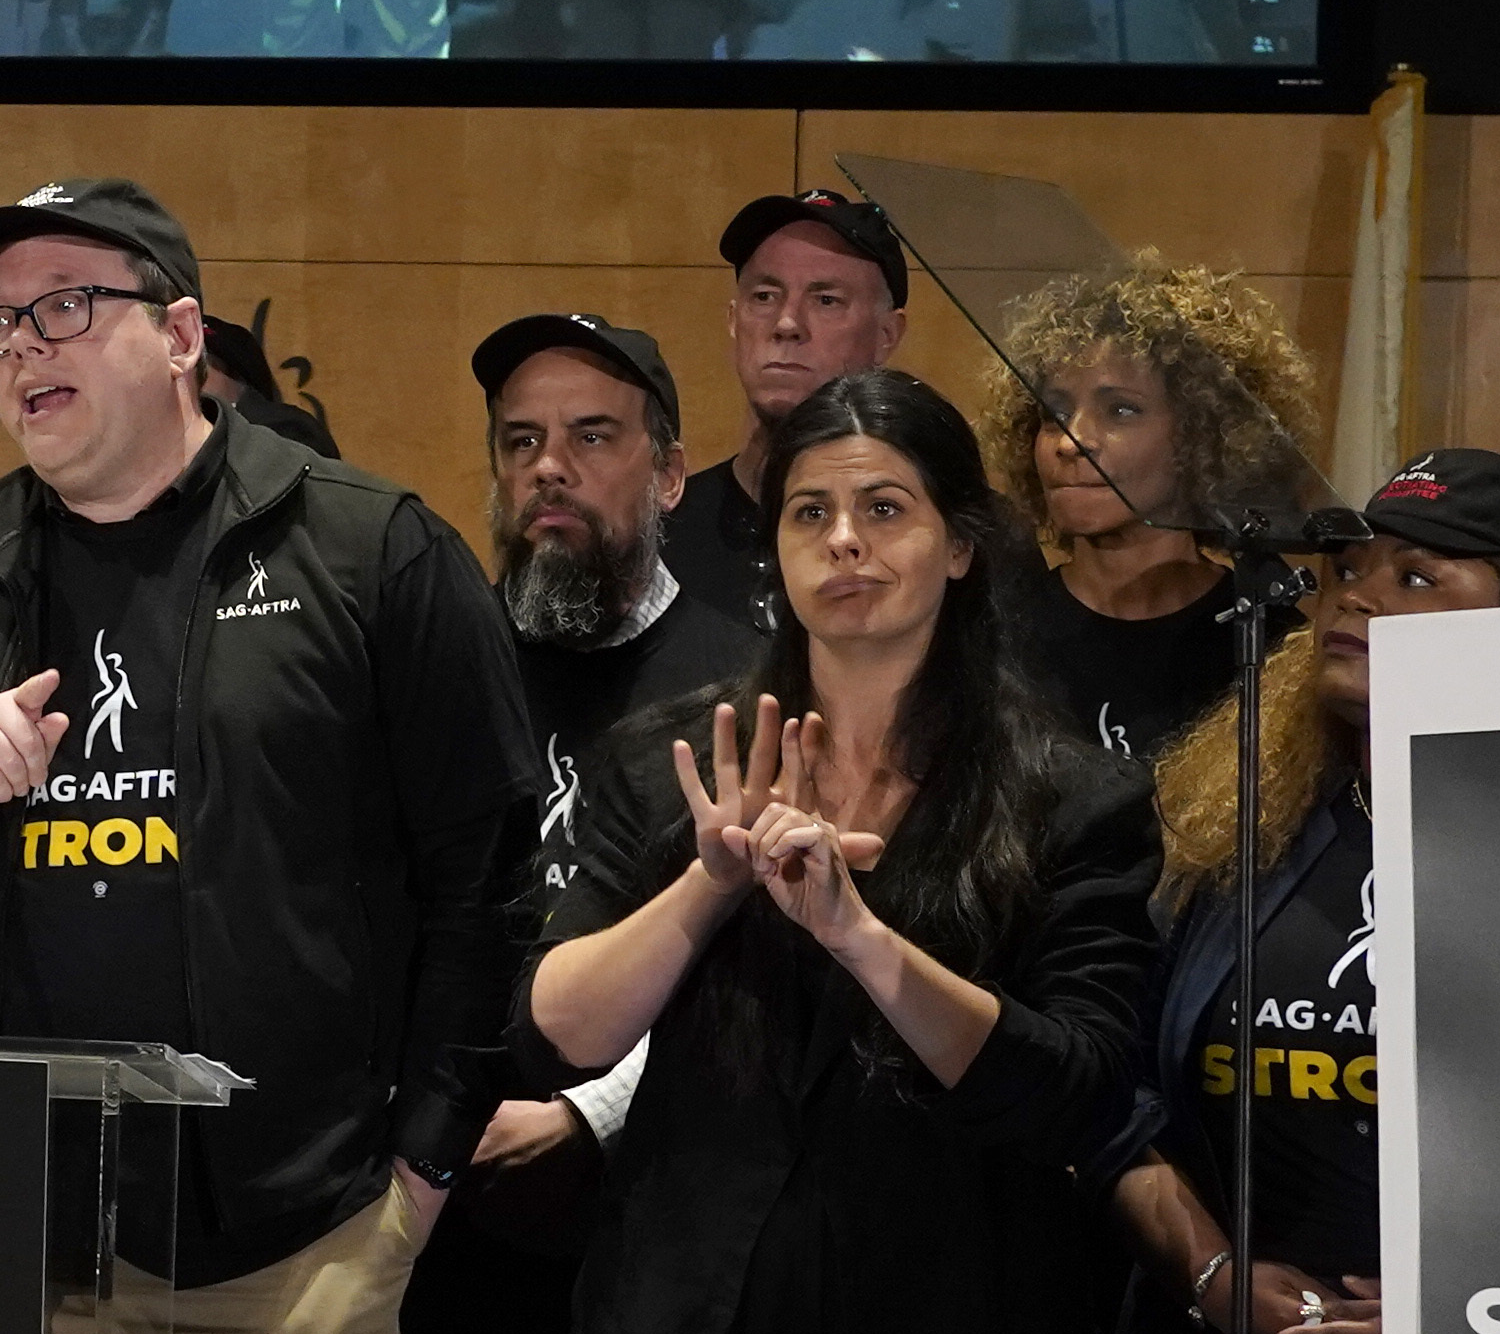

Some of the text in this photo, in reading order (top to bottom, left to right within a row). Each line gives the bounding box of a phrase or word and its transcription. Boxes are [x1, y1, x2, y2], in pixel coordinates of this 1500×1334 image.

[216, 597, 302, 621] SAG·AFTRA
[20, 815, 180, 870] TRON
[1203, 1044, 1379, 1104] STRO
